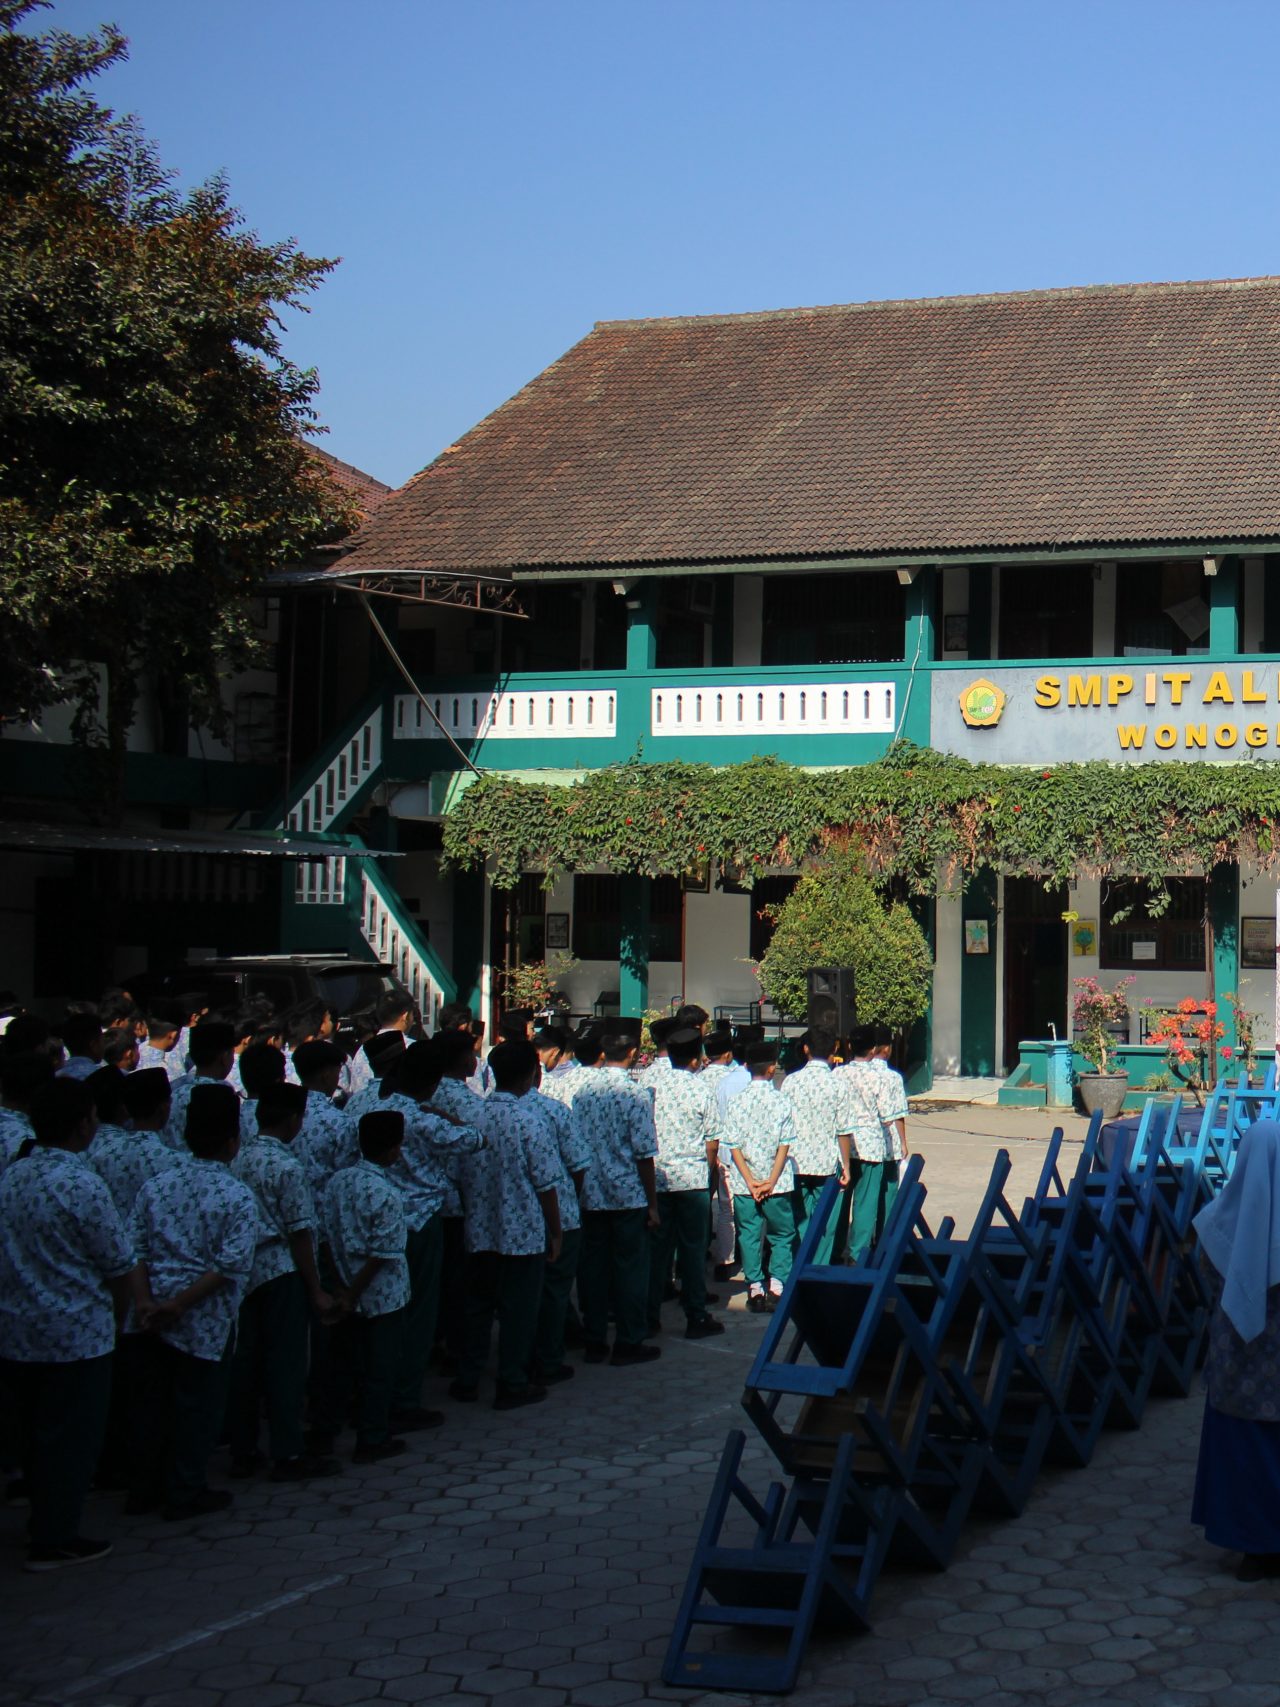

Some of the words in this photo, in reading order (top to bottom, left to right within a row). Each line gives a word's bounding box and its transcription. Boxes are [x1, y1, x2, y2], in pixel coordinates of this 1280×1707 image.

[1034, 674, 1134, 708] SMP
[1145, 672, 1191, 706] IT
[1202, 671, 1267, 704] AL
